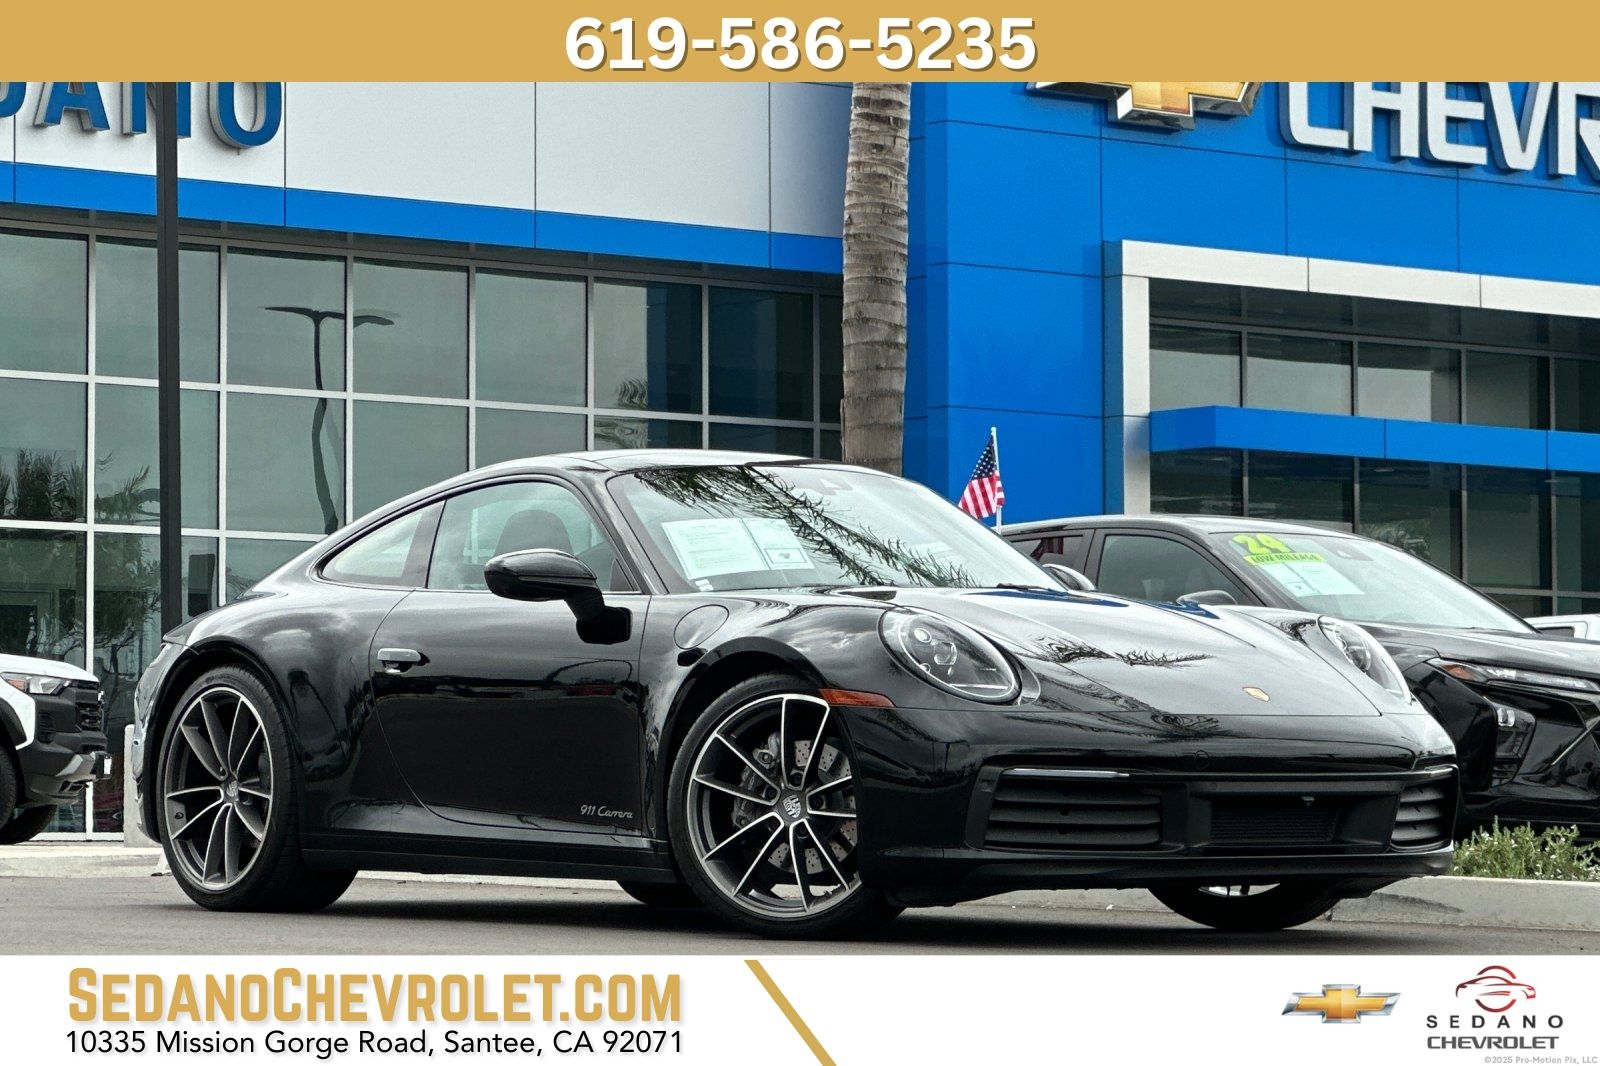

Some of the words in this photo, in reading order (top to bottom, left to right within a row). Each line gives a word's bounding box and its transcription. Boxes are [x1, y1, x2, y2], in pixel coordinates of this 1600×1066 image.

[1232, 534, 1293, 554] 24
[1250, 555, 1274, 564] LOW
[580, 804, 596, 816] 911
[597, 805, 633, 819] Carrera
